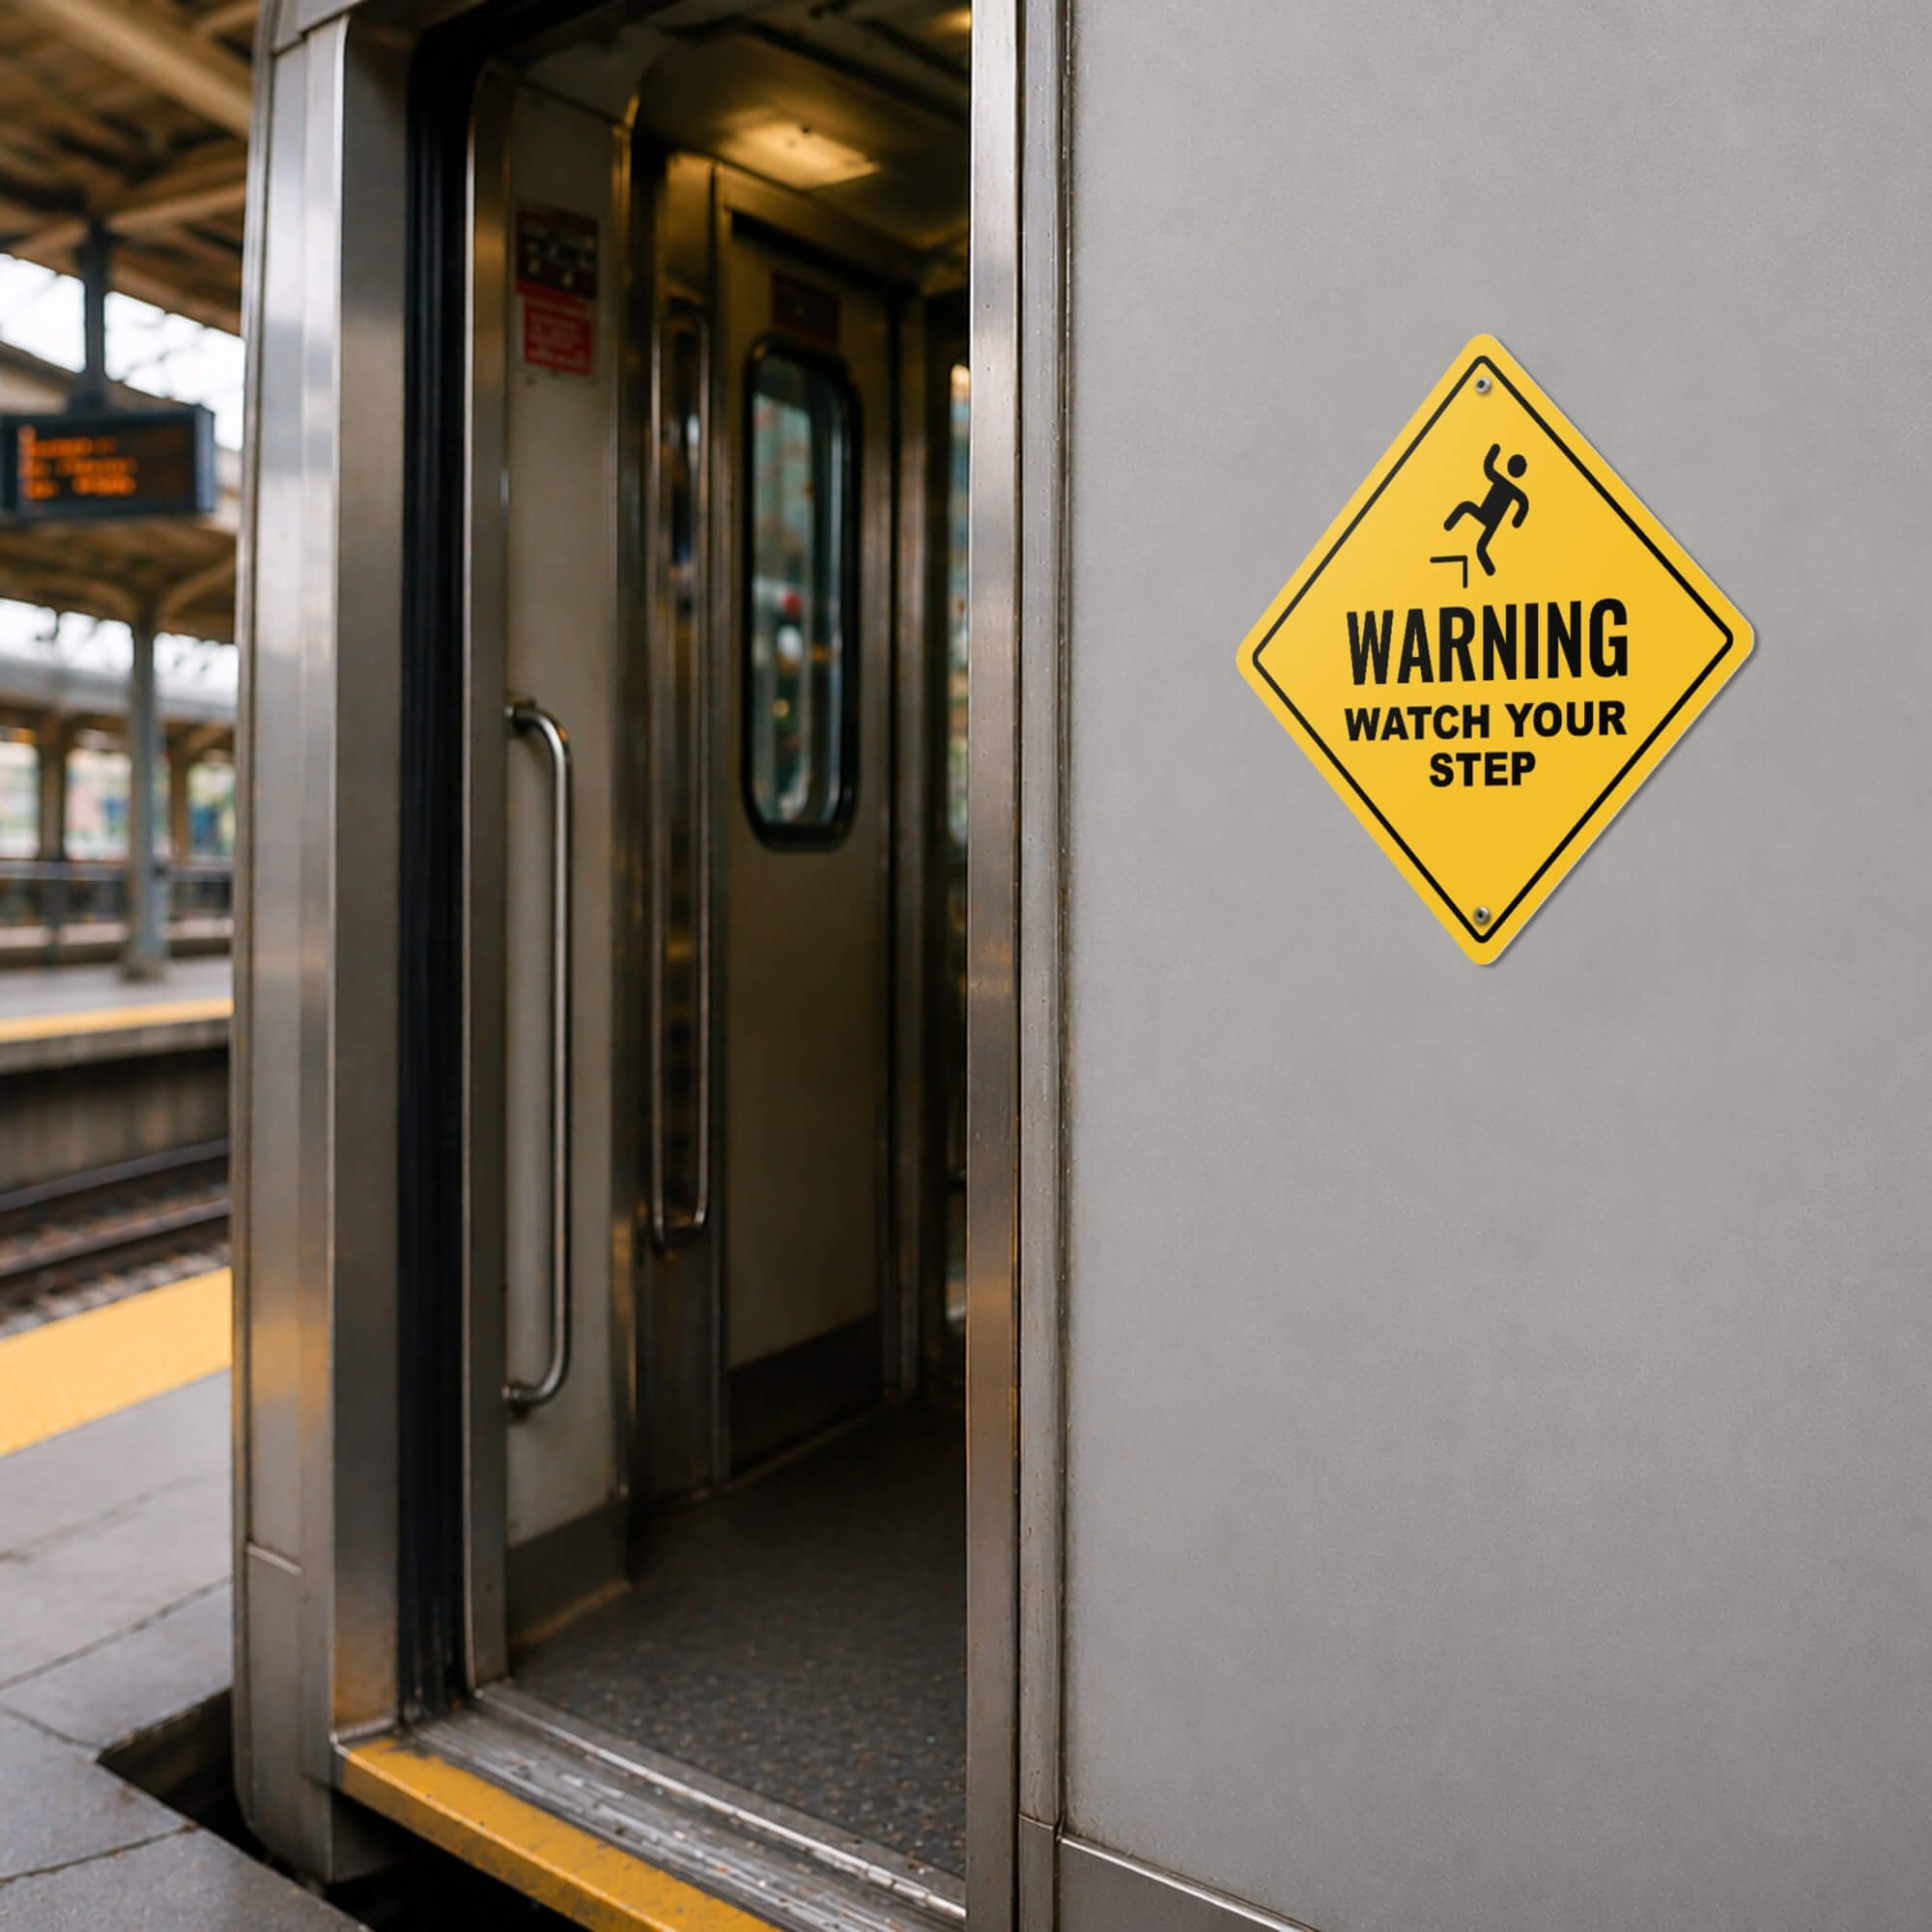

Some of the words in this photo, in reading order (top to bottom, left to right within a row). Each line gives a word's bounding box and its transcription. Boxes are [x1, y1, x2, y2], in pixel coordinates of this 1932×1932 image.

[1346, 598, 1629, 686] WARNING
[1344, 704, 1491, 742] WATCH
[1504, 699, 1628, 739] YOUR
[1429, 751, 1536, 788] STEP
